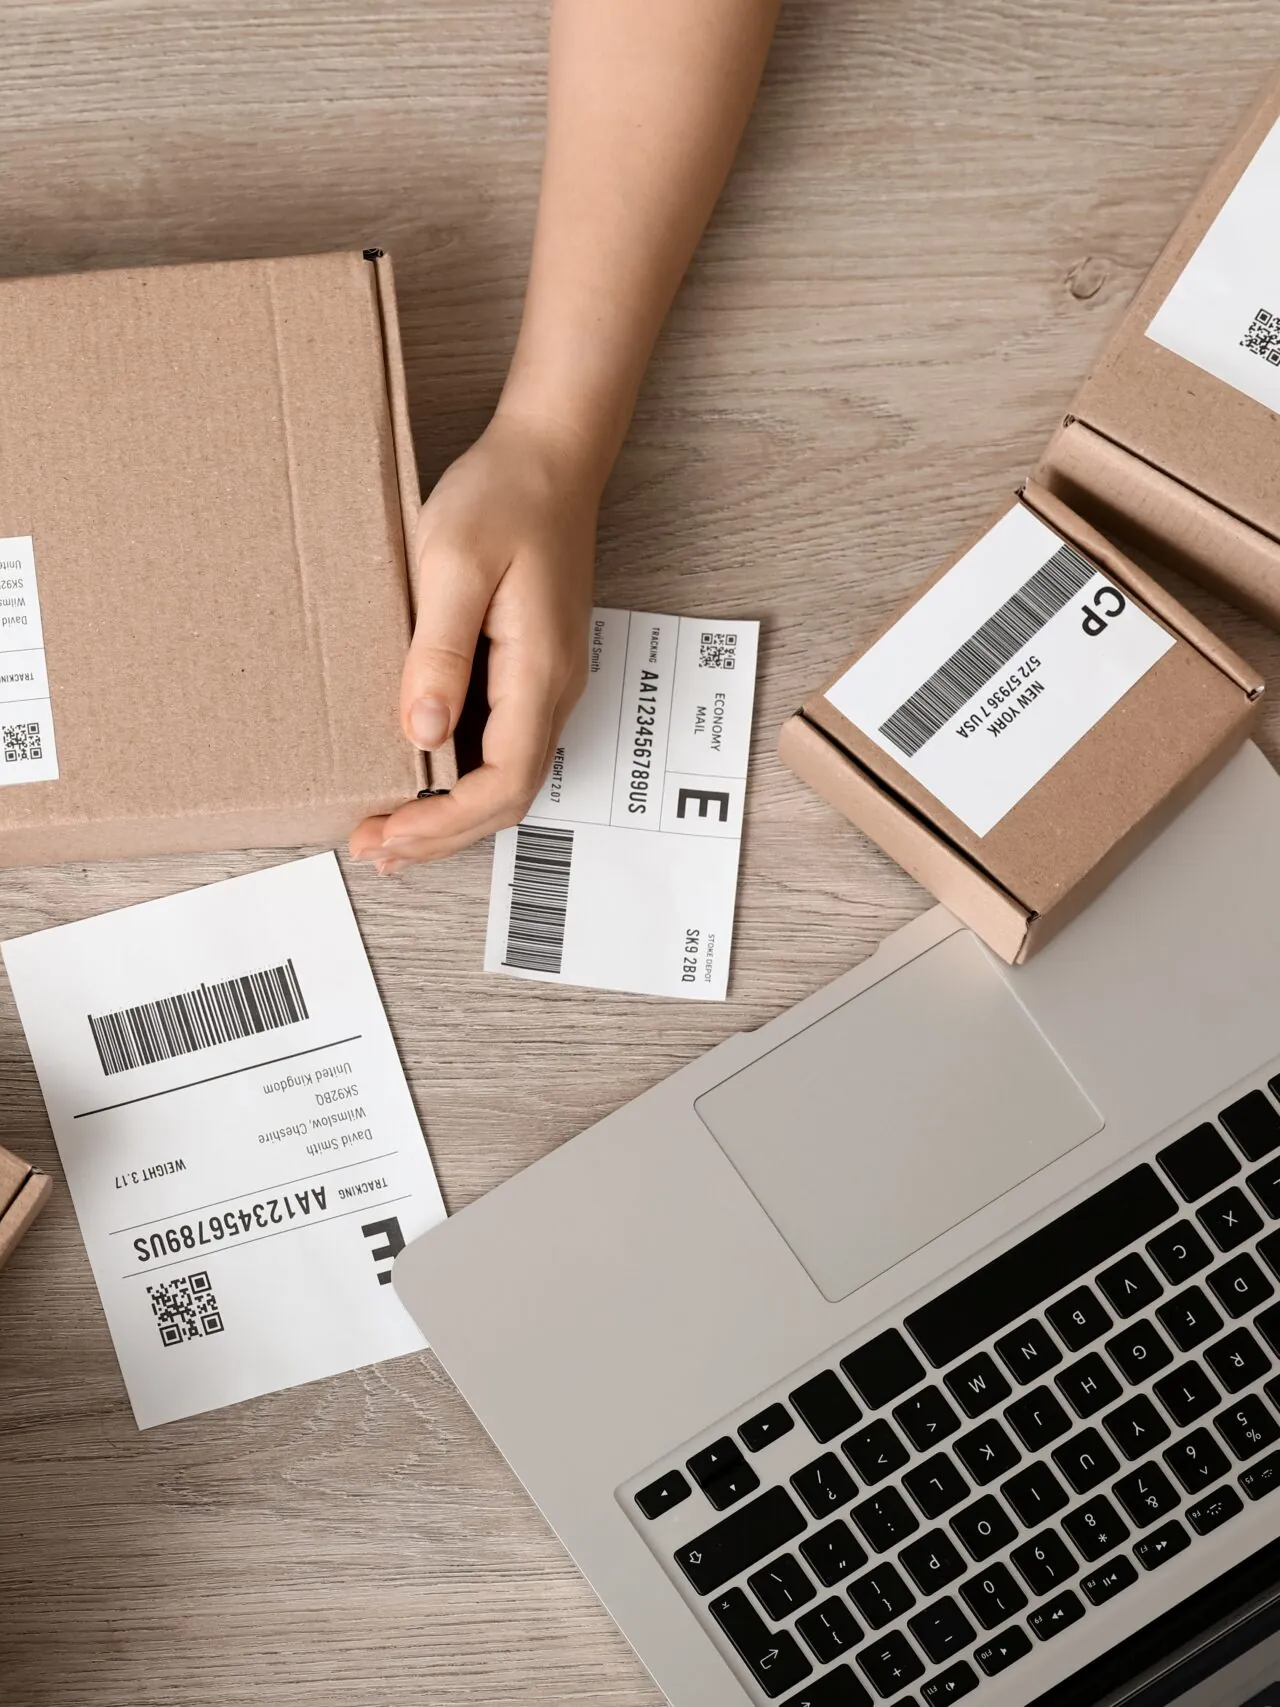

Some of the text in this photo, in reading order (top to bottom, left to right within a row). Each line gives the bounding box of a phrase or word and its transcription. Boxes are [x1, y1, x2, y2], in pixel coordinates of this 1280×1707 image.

[1081, 586, 1125, 636] CP
[2, 616, 27, 627] David
[590, 621, 605, 672] David Smith
[649, 627, 660, 663] TRACKING
[956, 656, 1041, 738] 572 57936 7 USA
[987, 681, 1044, 737] NEW YORK
[694, 706, 706, 734] MAIL
[711, 693, 725, 751] ECONOMY
[628, 670, 659, 813] AA123456789US
[550, 747, 565, 803] WEIGHT 2.07
[677, 788, 729, 822] E
[707, 934, 715, 957] STOKE
[682, 929, 699, 982] SK9 2BQ
[263, 1063, 352, 1094] United Kingdom
[315, 1085, 358, 1105] SK92BQ
[258, 1107, 366, 1143] Wilmslow, Cheshire
[306, 1129, 372, 1156] David Smith
[116, 1159, 186, 1189] WEIGHT 3.17
[338, 1178, 388, 1199] TRACKING
[134, 1186, 326, 1262] AA123456789US
[1222, 1210, 1238, 1227] X
[361, 1216, 406, 1285] E
[1172, 1244, 1187, 1259] C
[1124, 1279, 1138, 1294] V
[1234, 1277, 1249, 1293] D
[1072, 1310, 1086, 1325] B
[1186, 1311, 1196, 1326] F
[1020, 1343, 1038, 1360] N
[1132, 1345, 1147, 1360] G
[1229, 1352, 1245, 1367] R
[967, 1375, 986, 1393] M
[1080, 1376, 1097, 1394] H
[1183, 1387, 1196, 1402] T
[1033, 1411, 1043, 1426] J
[1236, 1411, 1248, 1426] 5
[1132, 1421, 1145, 1437] Y
[979, 1444, 995, 1461] K
[1186, 1445, 1196, 1459] 6
[1079, 1453, 1095, 1470] U
[929, 1478, 944, 1491] L
[1138, 1478, 1148, 1494] 7
[977, 1520, 992, 1536] O
[1084, 1513, 1097, 1527] 8
[1034, 1546, 1045, 1560] 9
[929, 1554, 941, 1570] P
[983, 1580, 995, 1594] 0
